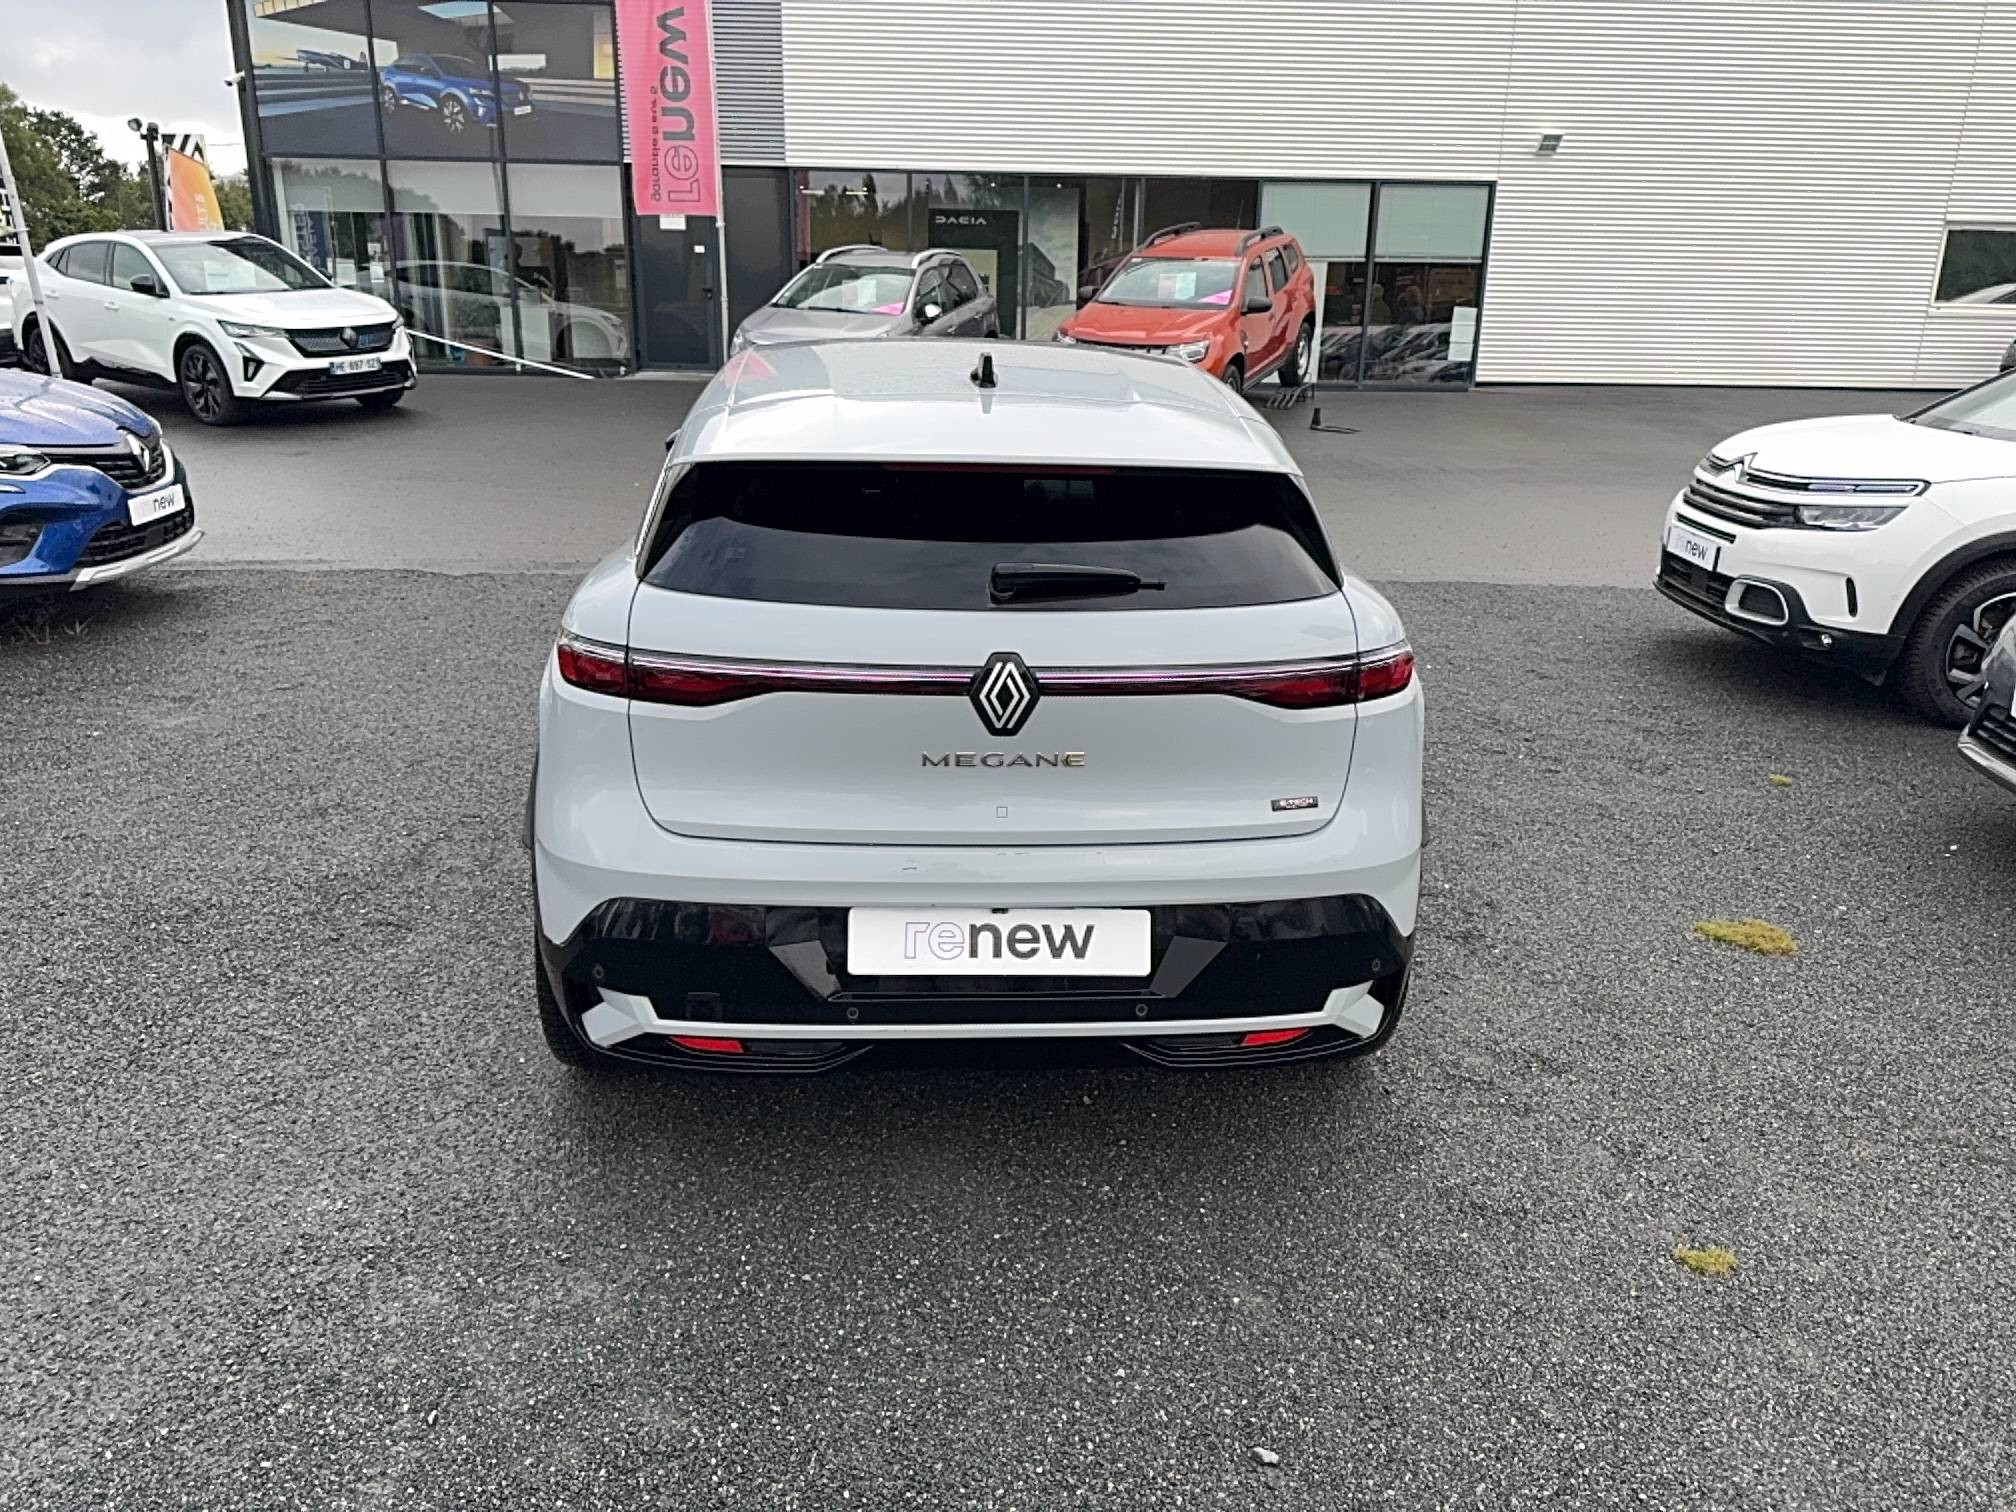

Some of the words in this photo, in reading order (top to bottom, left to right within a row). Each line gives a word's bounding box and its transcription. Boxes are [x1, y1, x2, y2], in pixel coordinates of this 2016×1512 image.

[935, 215, 987, 225] DACIA
[921, 750, 1086, 768] MEGANE
[904, 921, 1096, 961] renew
